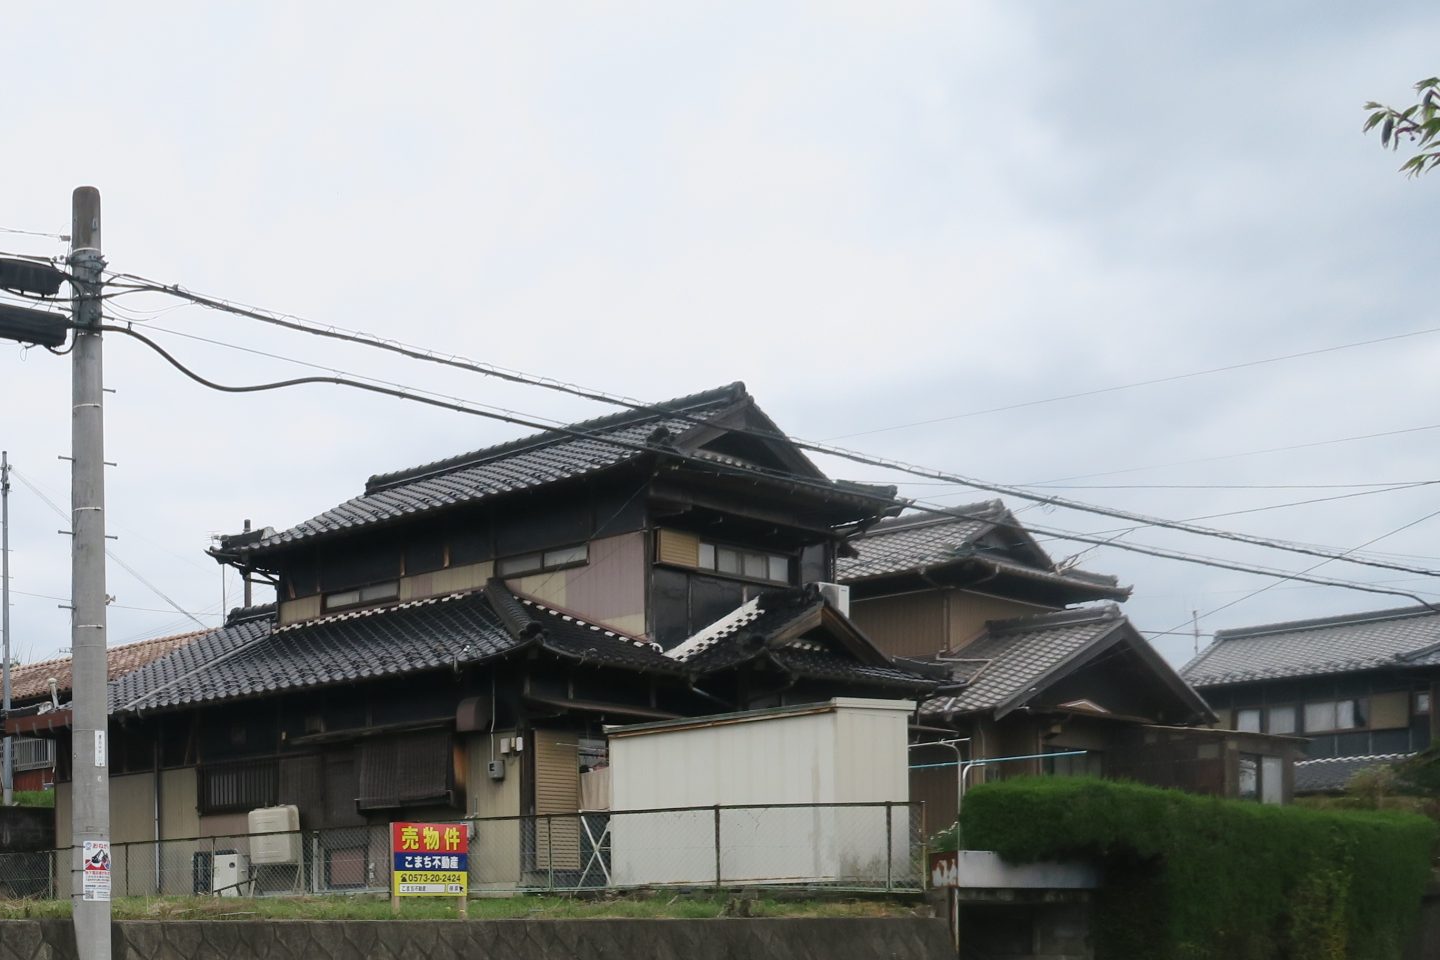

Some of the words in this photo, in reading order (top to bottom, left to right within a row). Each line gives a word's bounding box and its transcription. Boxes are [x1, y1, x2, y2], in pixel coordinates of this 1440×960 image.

[401, 826, 460, 850] 売物件
[405, 856, 459, 869] こまち不動産
[408, 873, 461, 882] 0573-20-2424
